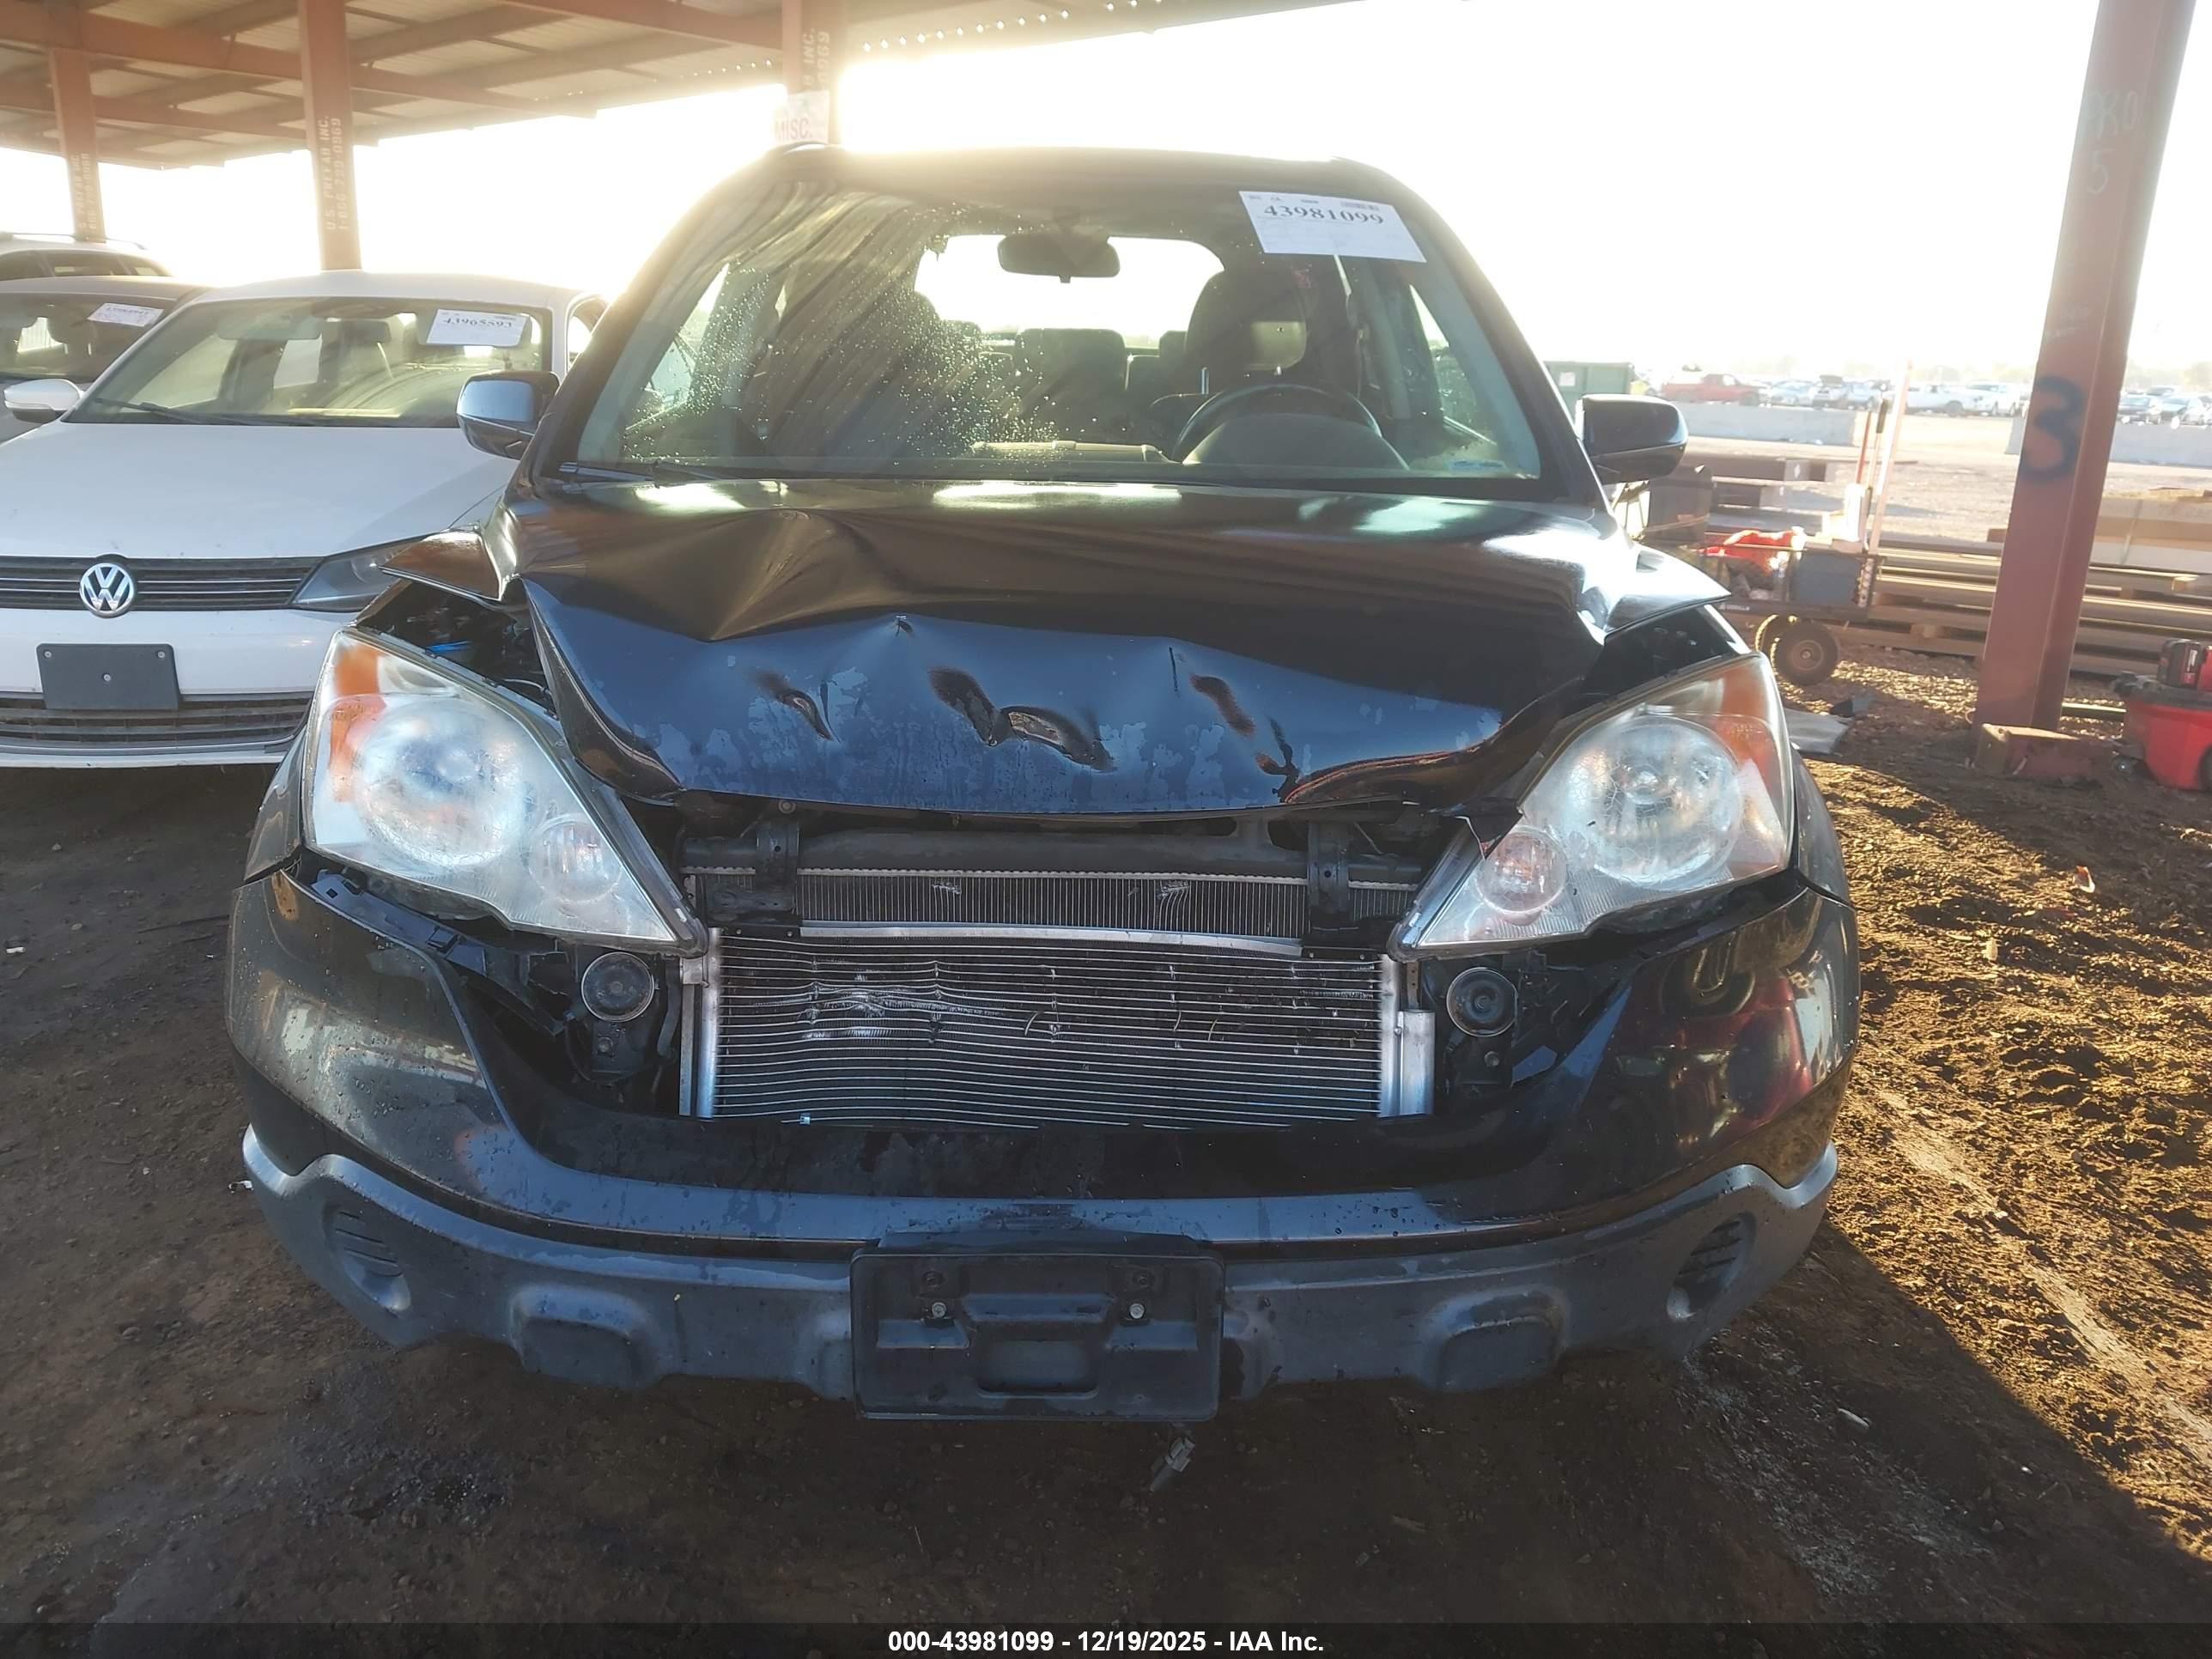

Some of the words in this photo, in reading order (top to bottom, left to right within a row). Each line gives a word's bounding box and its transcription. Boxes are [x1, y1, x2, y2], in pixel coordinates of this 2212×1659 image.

[1263, 204, 1385, 225] 43981099
[2020, 374, 2088, 480] 3
[80, 562, 135, 617] VW
